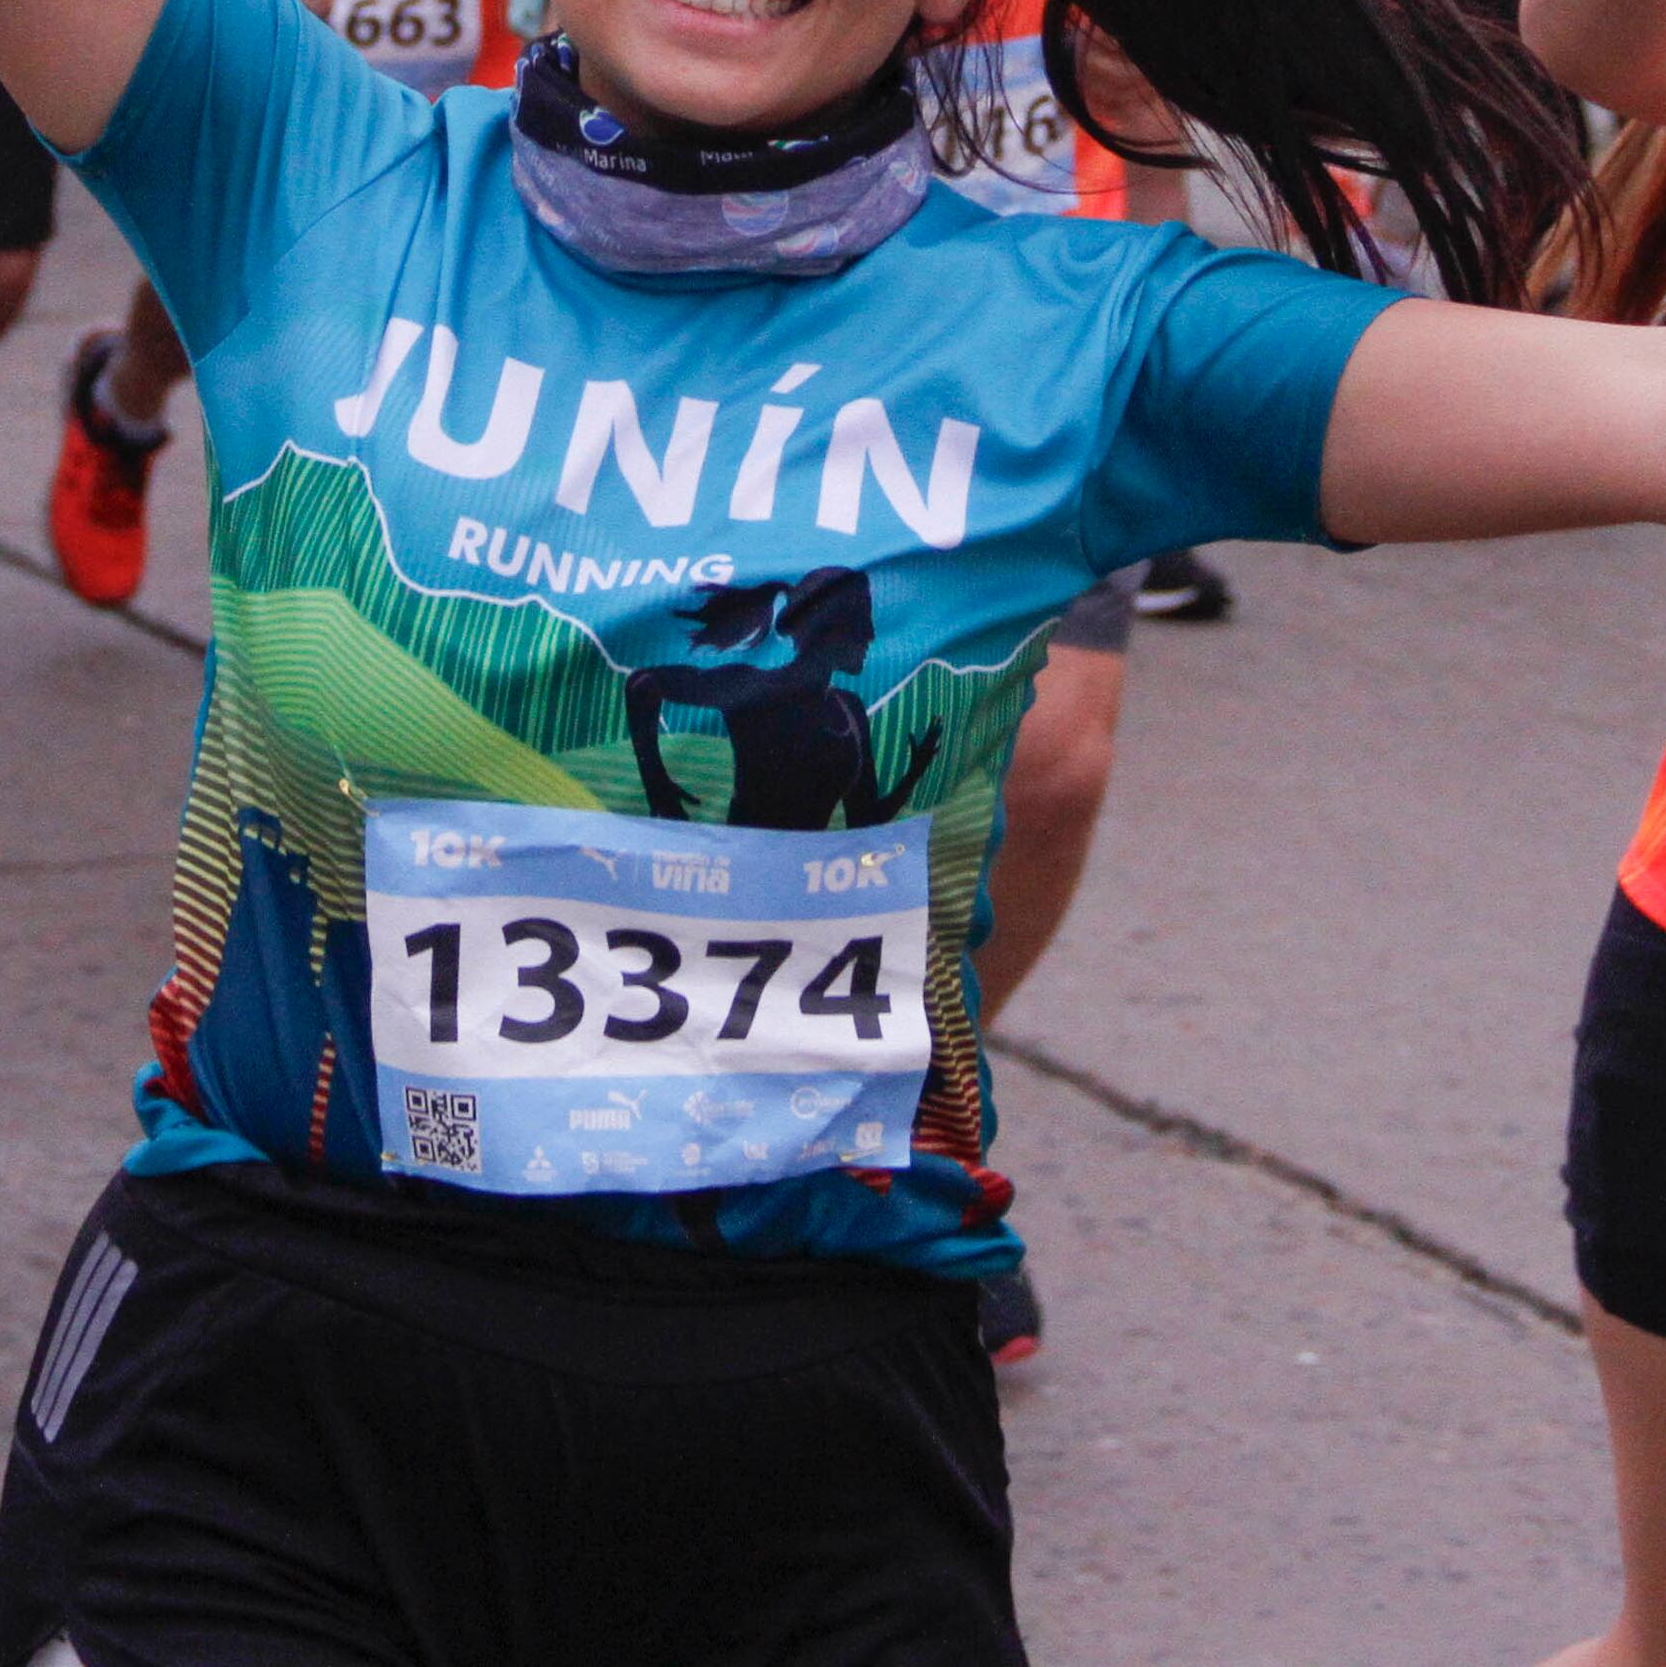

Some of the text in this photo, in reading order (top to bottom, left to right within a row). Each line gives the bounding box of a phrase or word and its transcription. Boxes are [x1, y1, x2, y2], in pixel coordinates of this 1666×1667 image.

[583, 147, 648, 174] Marina
[447, 516, 735, 595] RUNNING
[410, 828, 508, 869] 10K
[404, 916, 892, 1045] 13374
